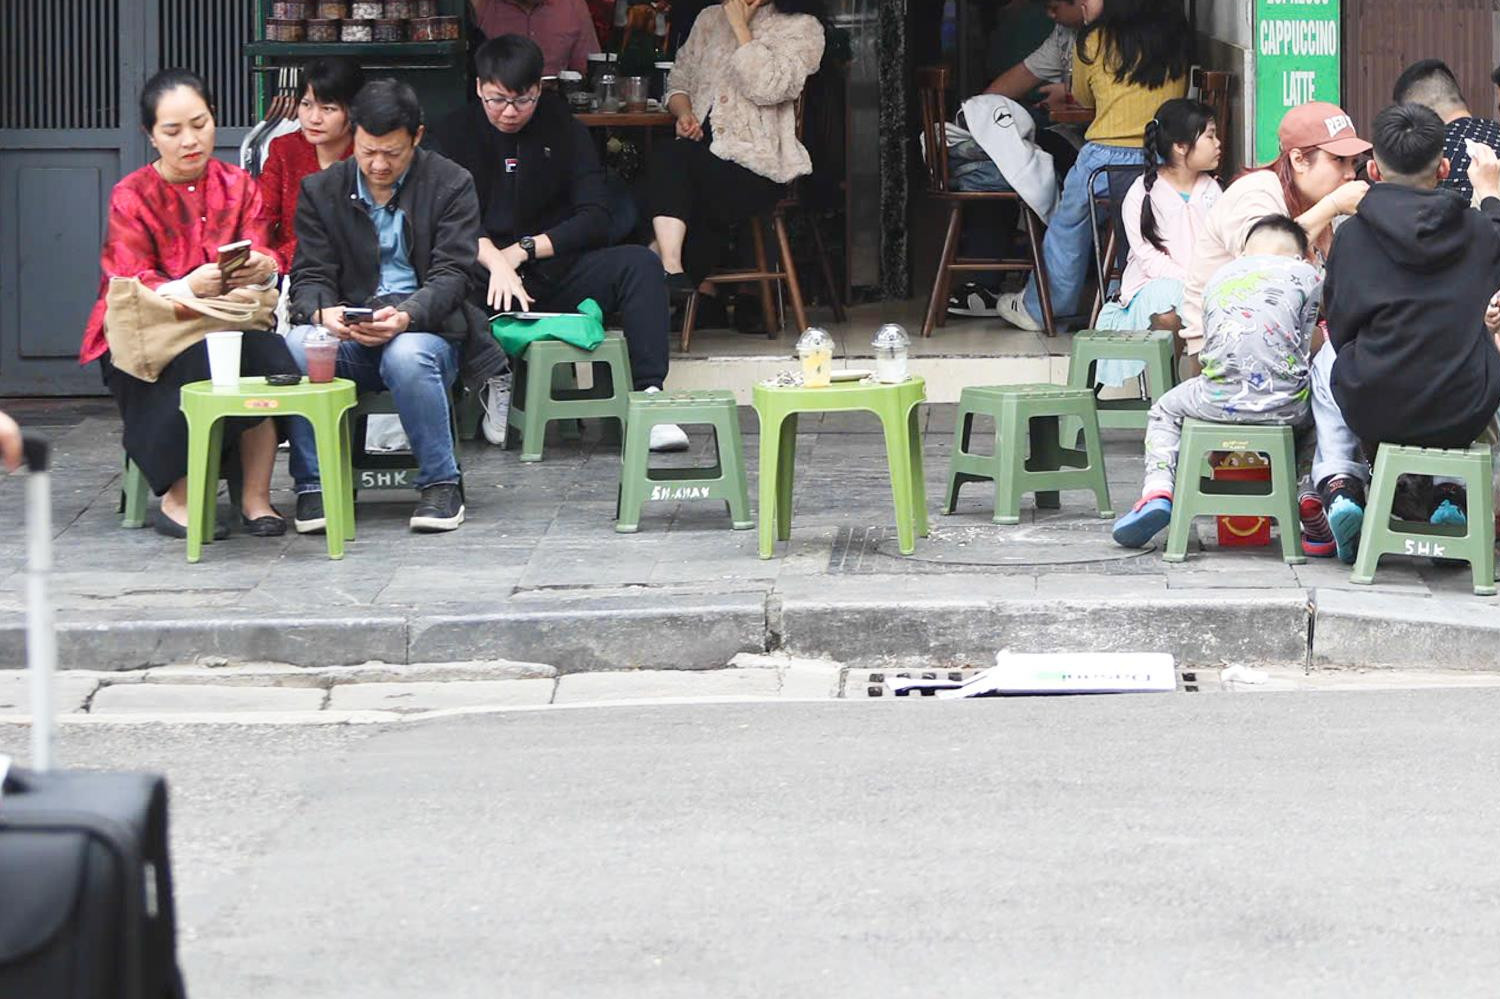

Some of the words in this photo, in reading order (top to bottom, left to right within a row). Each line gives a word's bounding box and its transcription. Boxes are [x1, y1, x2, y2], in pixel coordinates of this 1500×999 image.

[1260, 20, 1337, 56] CAPPUCCINO
[1283, 71, 1315, 107] LATTE
[362, 471, 408, 488] 5HK
[1404, 539, 1445, 556] 5HK
